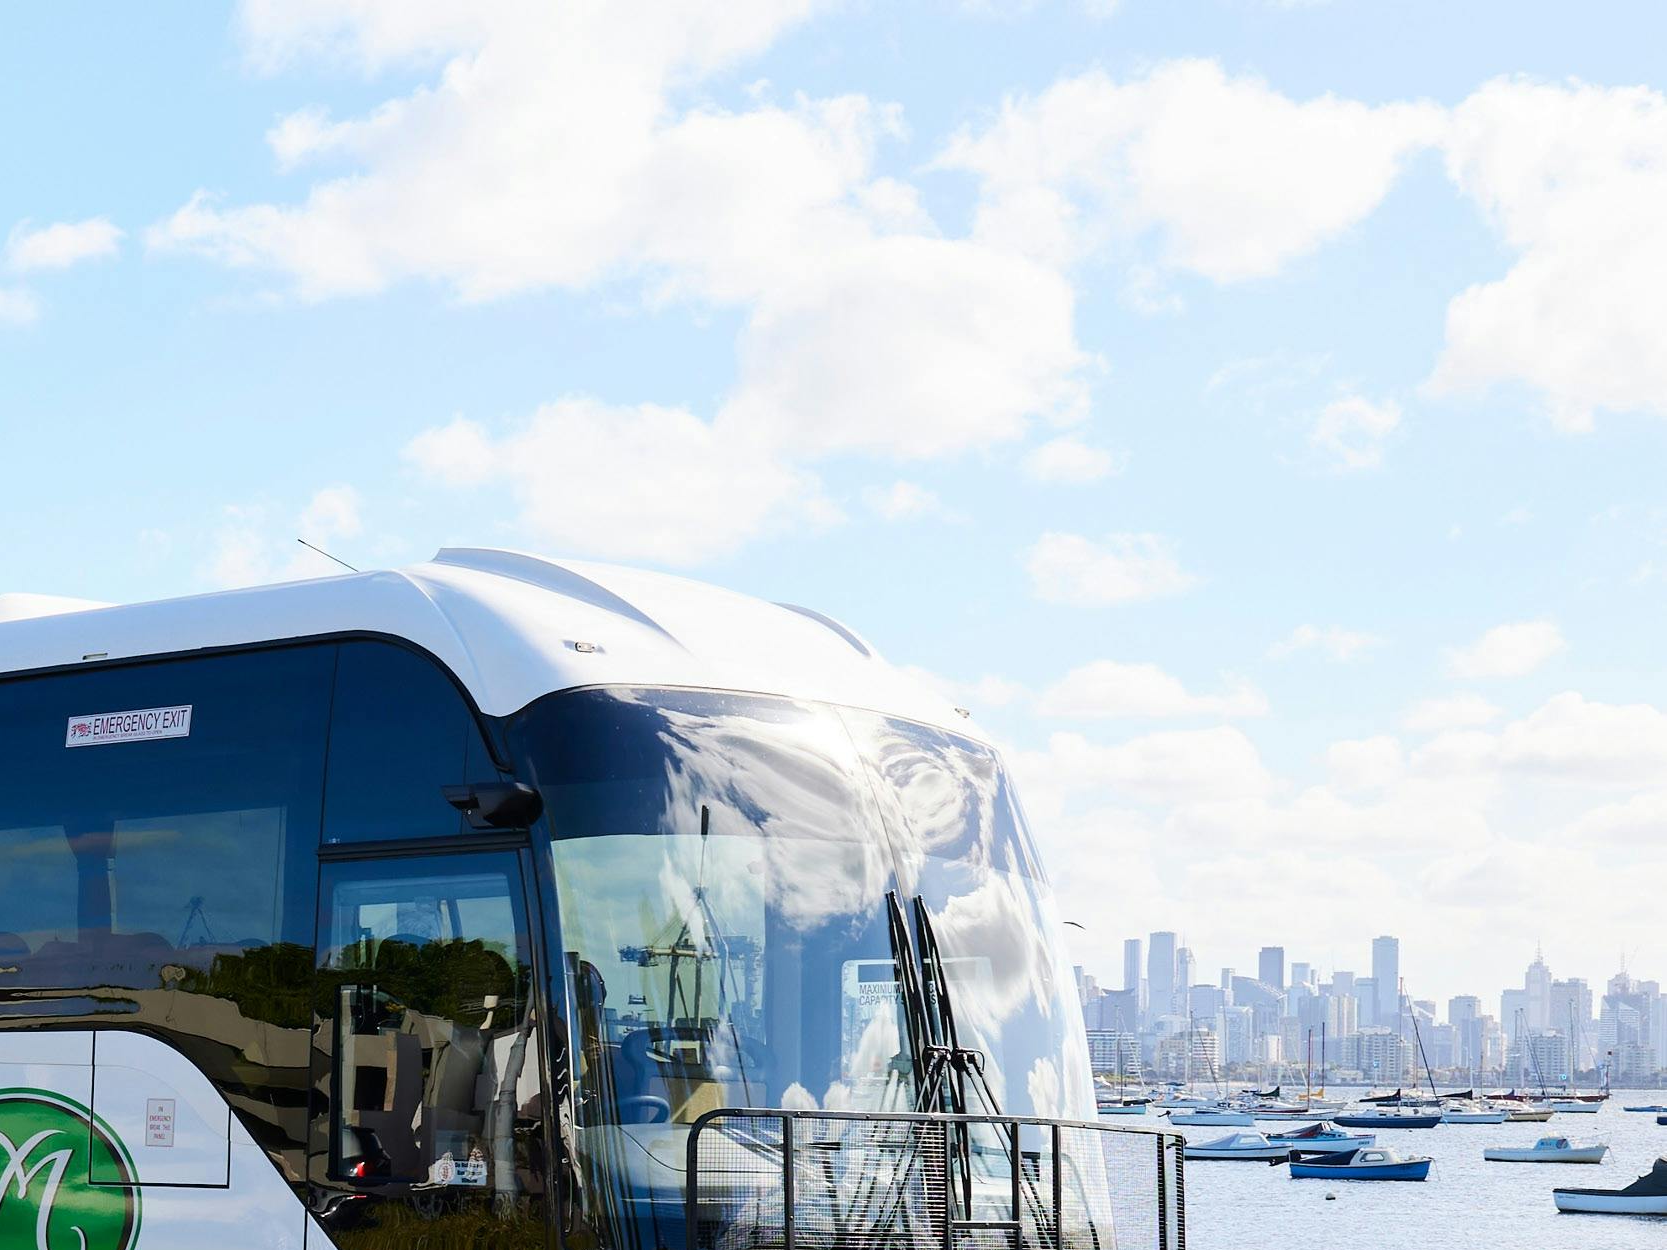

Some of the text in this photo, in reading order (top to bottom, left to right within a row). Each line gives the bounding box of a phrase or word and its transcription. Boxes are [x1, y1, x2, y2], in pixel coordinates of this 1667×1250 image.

[93, 709, 188, 736] EMERGENCY EXIT
[859, 984, 901, 994] MAXIMUM
